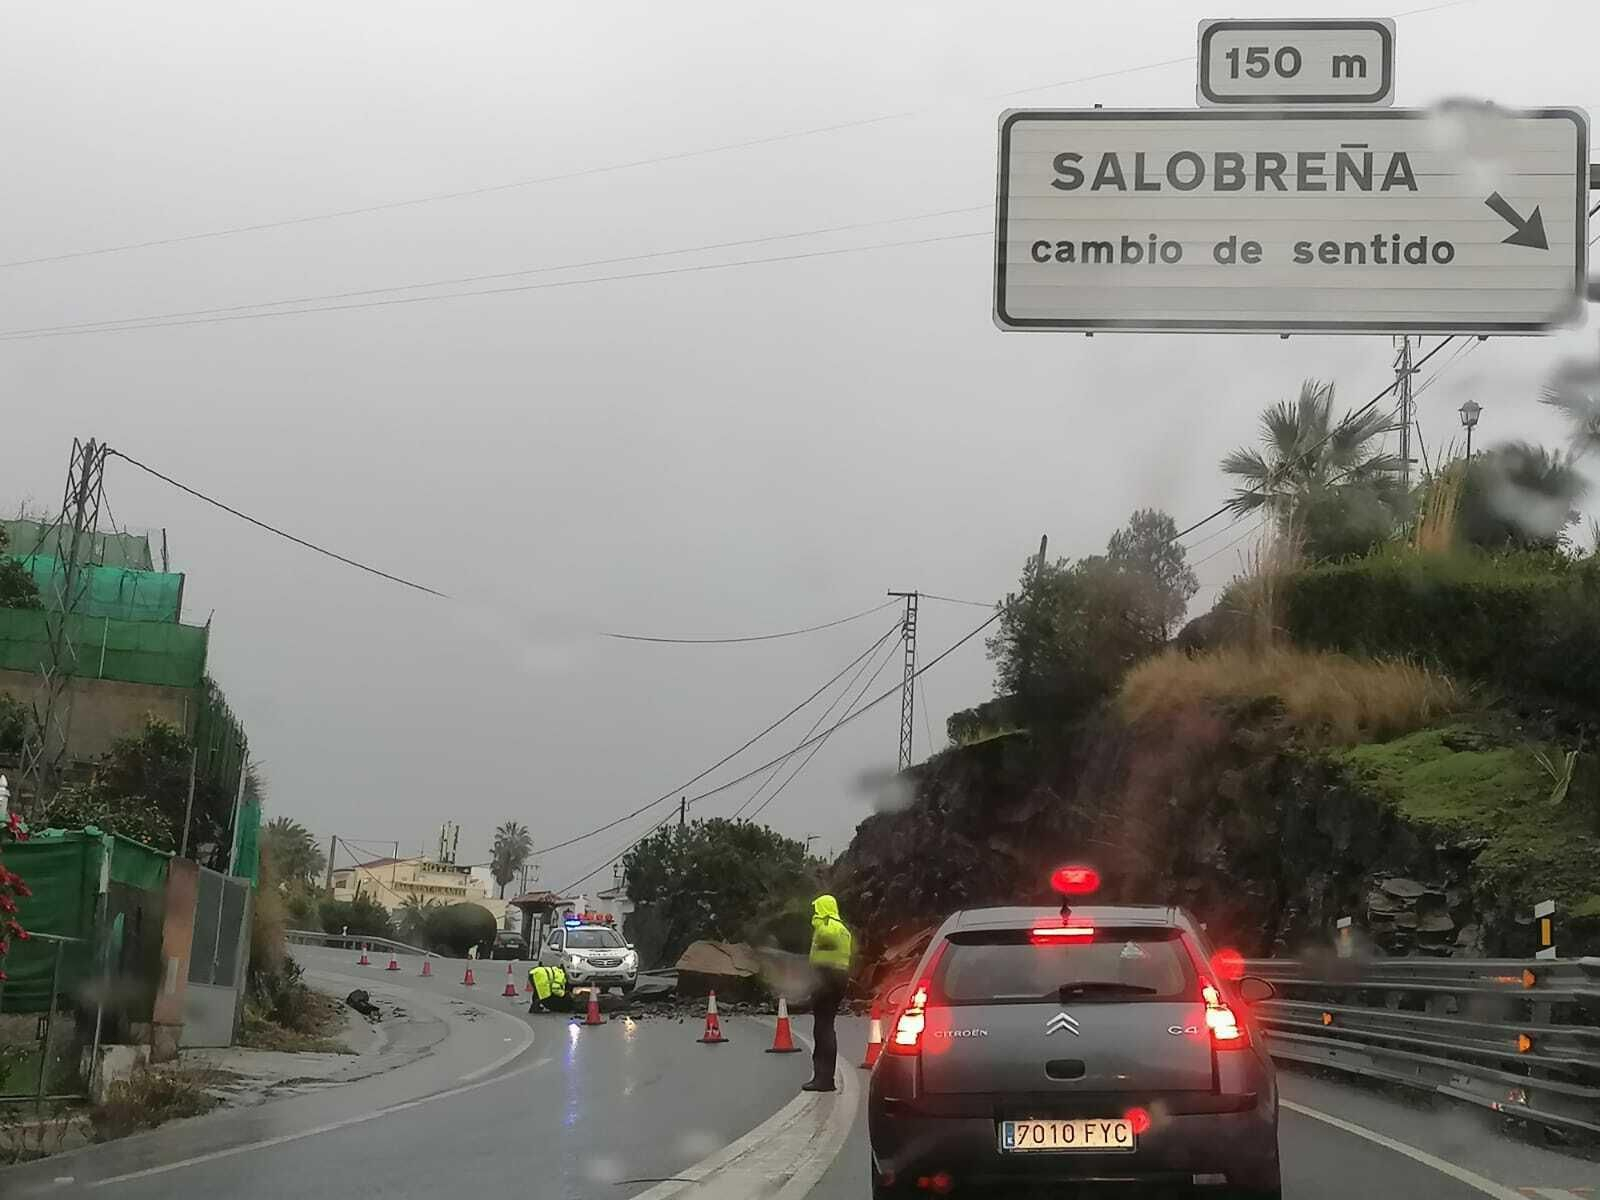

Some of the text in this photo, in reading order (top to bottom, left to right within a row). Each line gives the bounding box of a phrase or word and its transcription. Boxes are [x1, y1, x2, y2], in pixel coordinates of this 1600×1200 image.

[1225, 46, 1367, 79] 150 m
[1050, 144, 1419, 192] SALOBREÑA
[1031, 234, 1455, 265] cambio de sentido
[1167, 1025, 1197, 1035] C4
[1018, 1123, 1127, 1145] 7010 FYC
